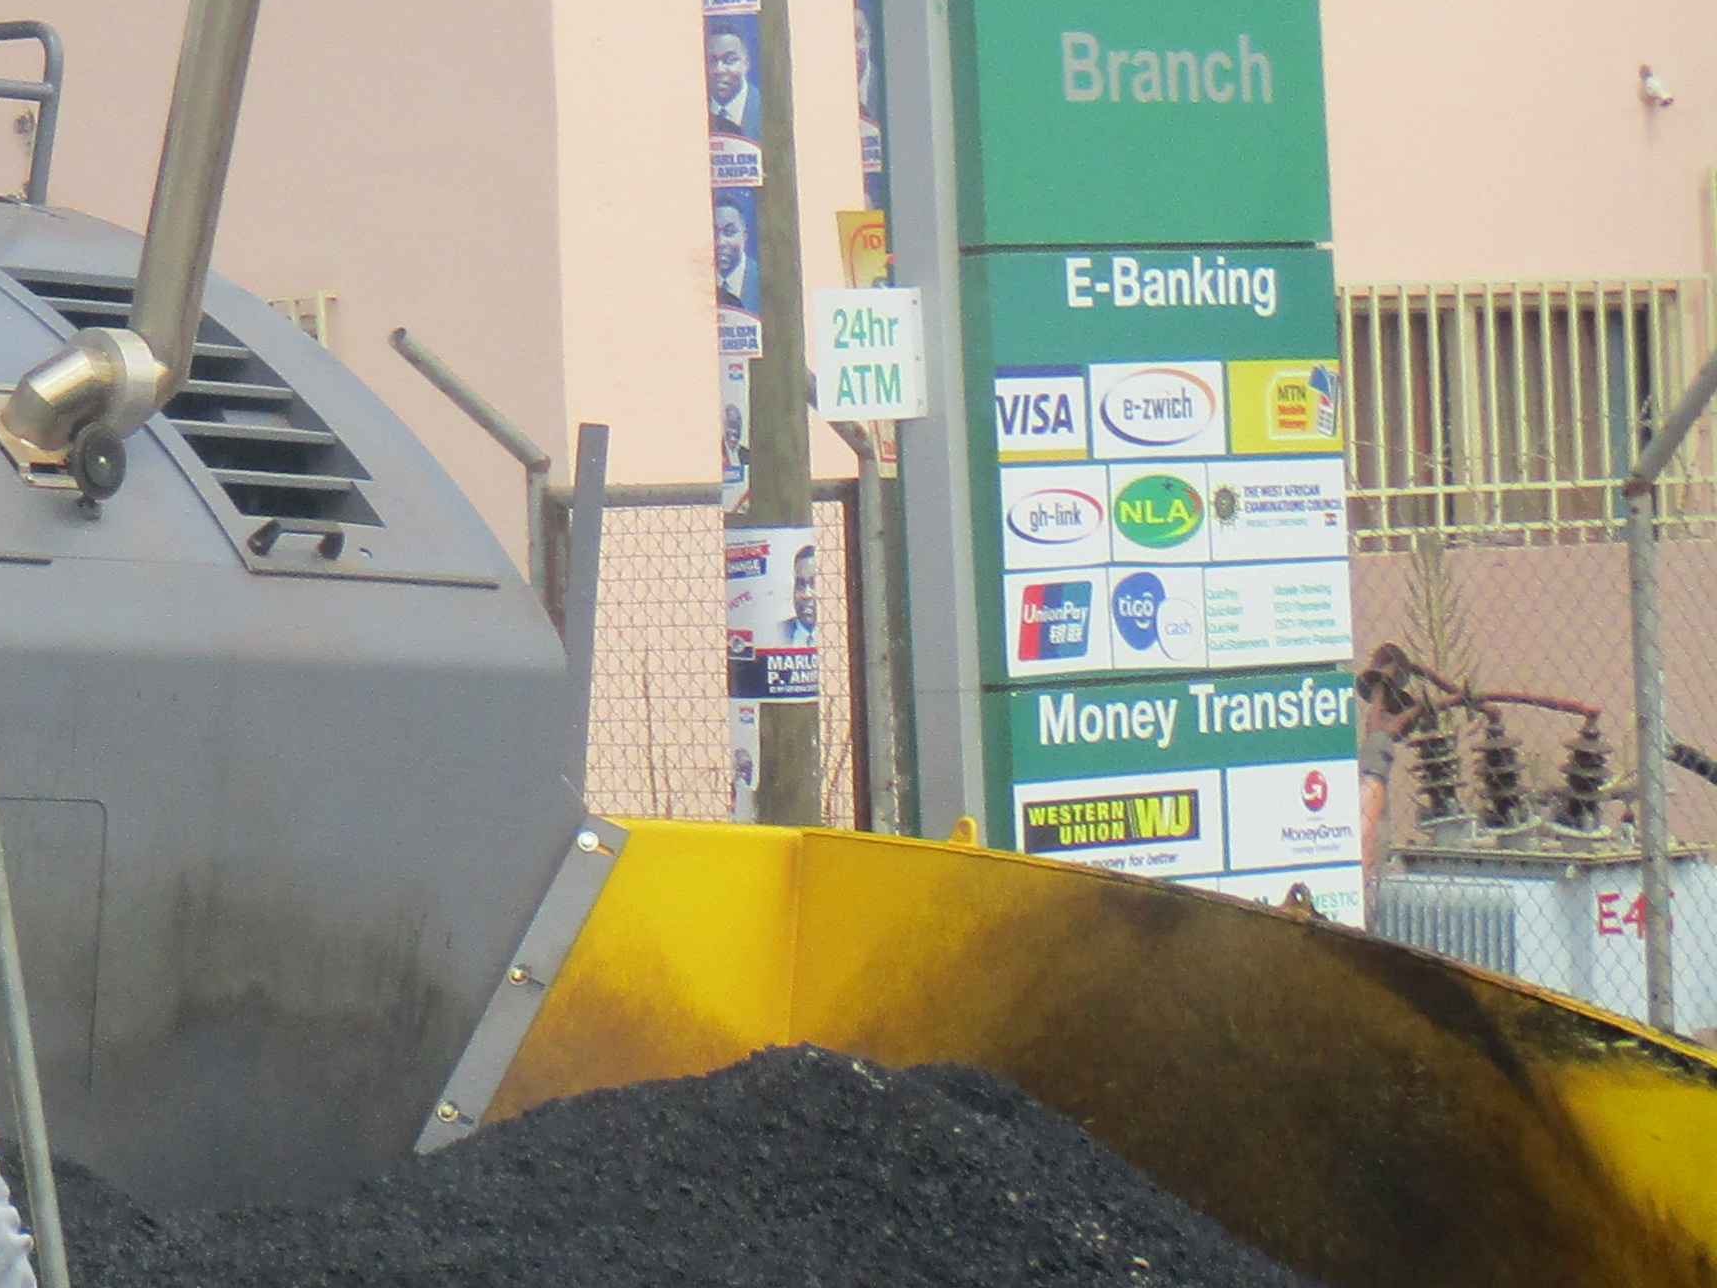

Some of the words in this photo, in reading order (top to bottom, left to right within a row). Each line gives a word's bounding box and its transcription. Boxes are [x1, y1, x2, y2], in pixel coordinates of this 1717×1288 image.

[1062, 31, 1273, 104] Branch
[1065, 256, 1278, 317] E-Banking
[834, 308, 900, 350] 24hr
[837, 363, 903, 407] ATM
[1123, 387, 1193, 421] e-zwich
[995, 394, 1075, 436] VISA
[1029, 504, 1082, 532] gh-link
[1119, 499, 1191, 524] NLA
[1038, 692, 1178, 749] Money
[1189, 678, 1354, 734] Transfer
[1028, 801, 1126, 826] WESTERN
[1059, 821, 1126, 846] UNION
[1133, 795, 1192, 839] WU
[1281, 824, 1353, 843] MoneyGram
[1596, 891, 1675, 940] E4
